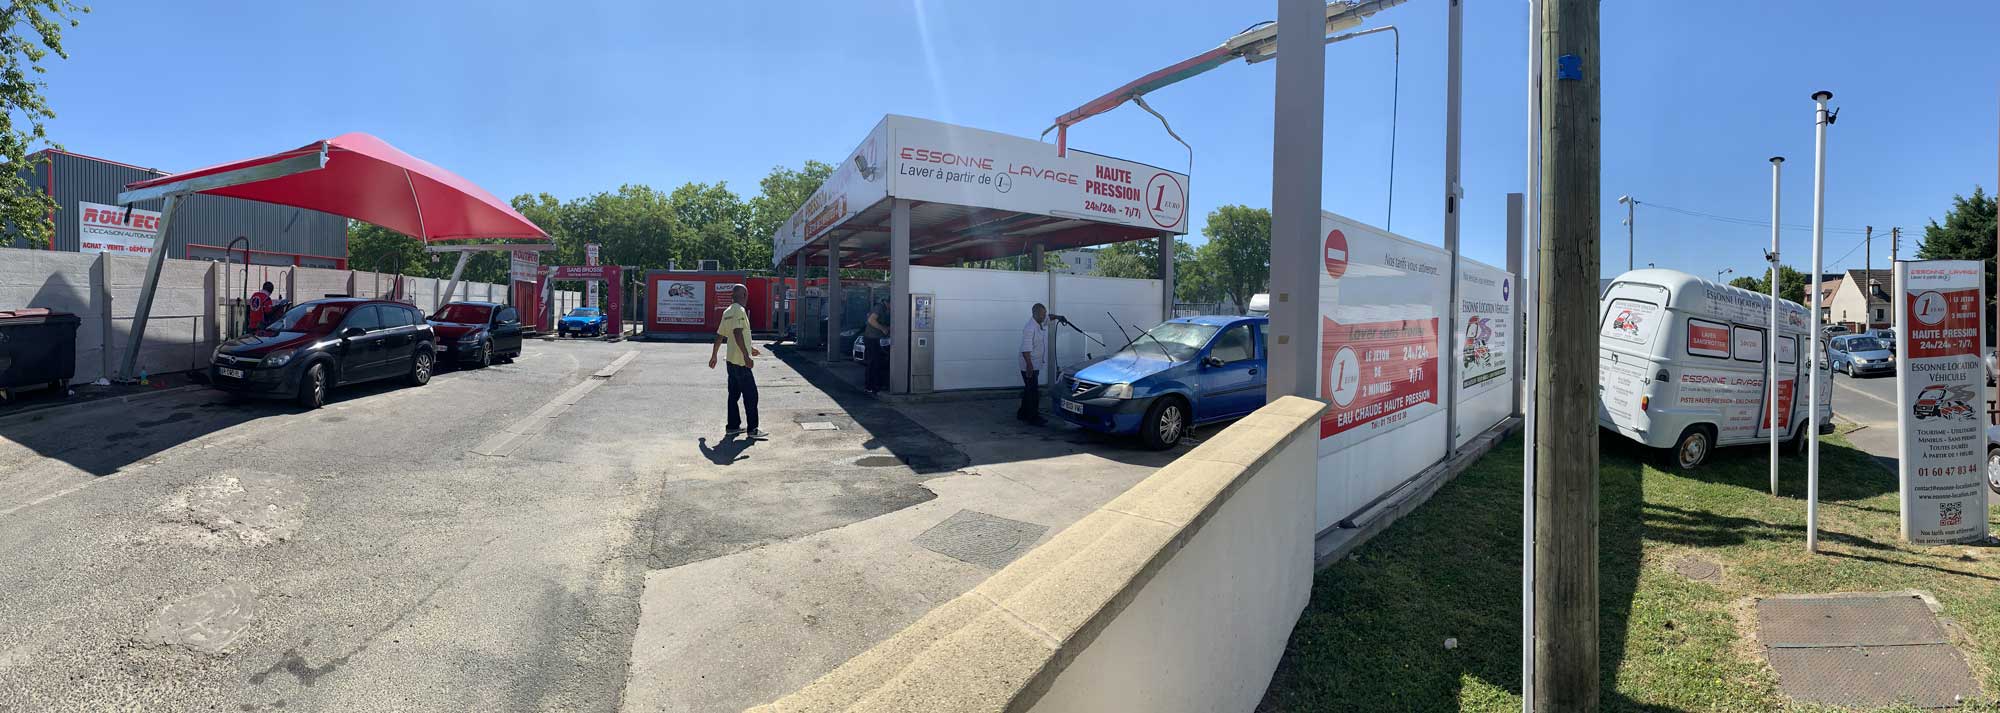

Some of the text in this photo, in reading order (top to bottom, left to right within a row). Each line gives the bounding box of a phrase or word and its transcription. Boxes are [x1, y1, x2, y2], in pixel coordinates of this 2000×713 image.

[900, 147, 1079, 185] ESSONNE LAVAGE
[900, 163, 934, 177] Laver
[936, 168, 943, 179] à
[946, 170, 974, 183] partir
[978, 173, 991, 185] de
[1096, 165, 1132, 184] HAUTE
[1085, 180, 1141, 202] PRESSION
[1152, 184, 1165, 212] 1
[1085, 200, 1116, 214] 24h/24h
[1164, 201, 1180, 209] EURO
[1706, 289, 1733, 304] ESSONNE
[1920, 297, 1931, 316] 1
[1912, 328, 1977, 339] HAUTE PRESSION
[1365, 350, 1390, 362] LE JETON
[1374, 366, 1382, 378] DE
[1911, 361, 1979, 372] ESSONNE LOCATION
[1335, 360, 1345, 392] 1
[1681, 374, 1763, 387] ESSONNE LAVAGE
[1929, 372, 1967, 382] VÉHICULES
[1368, 381, 1392, 396] MINUTES
[1337, 389, 1431, 427] EAU CHAUDE HAUTE PRESSION
[1918, 464, 1977, 477] 01 60 47 83 44
